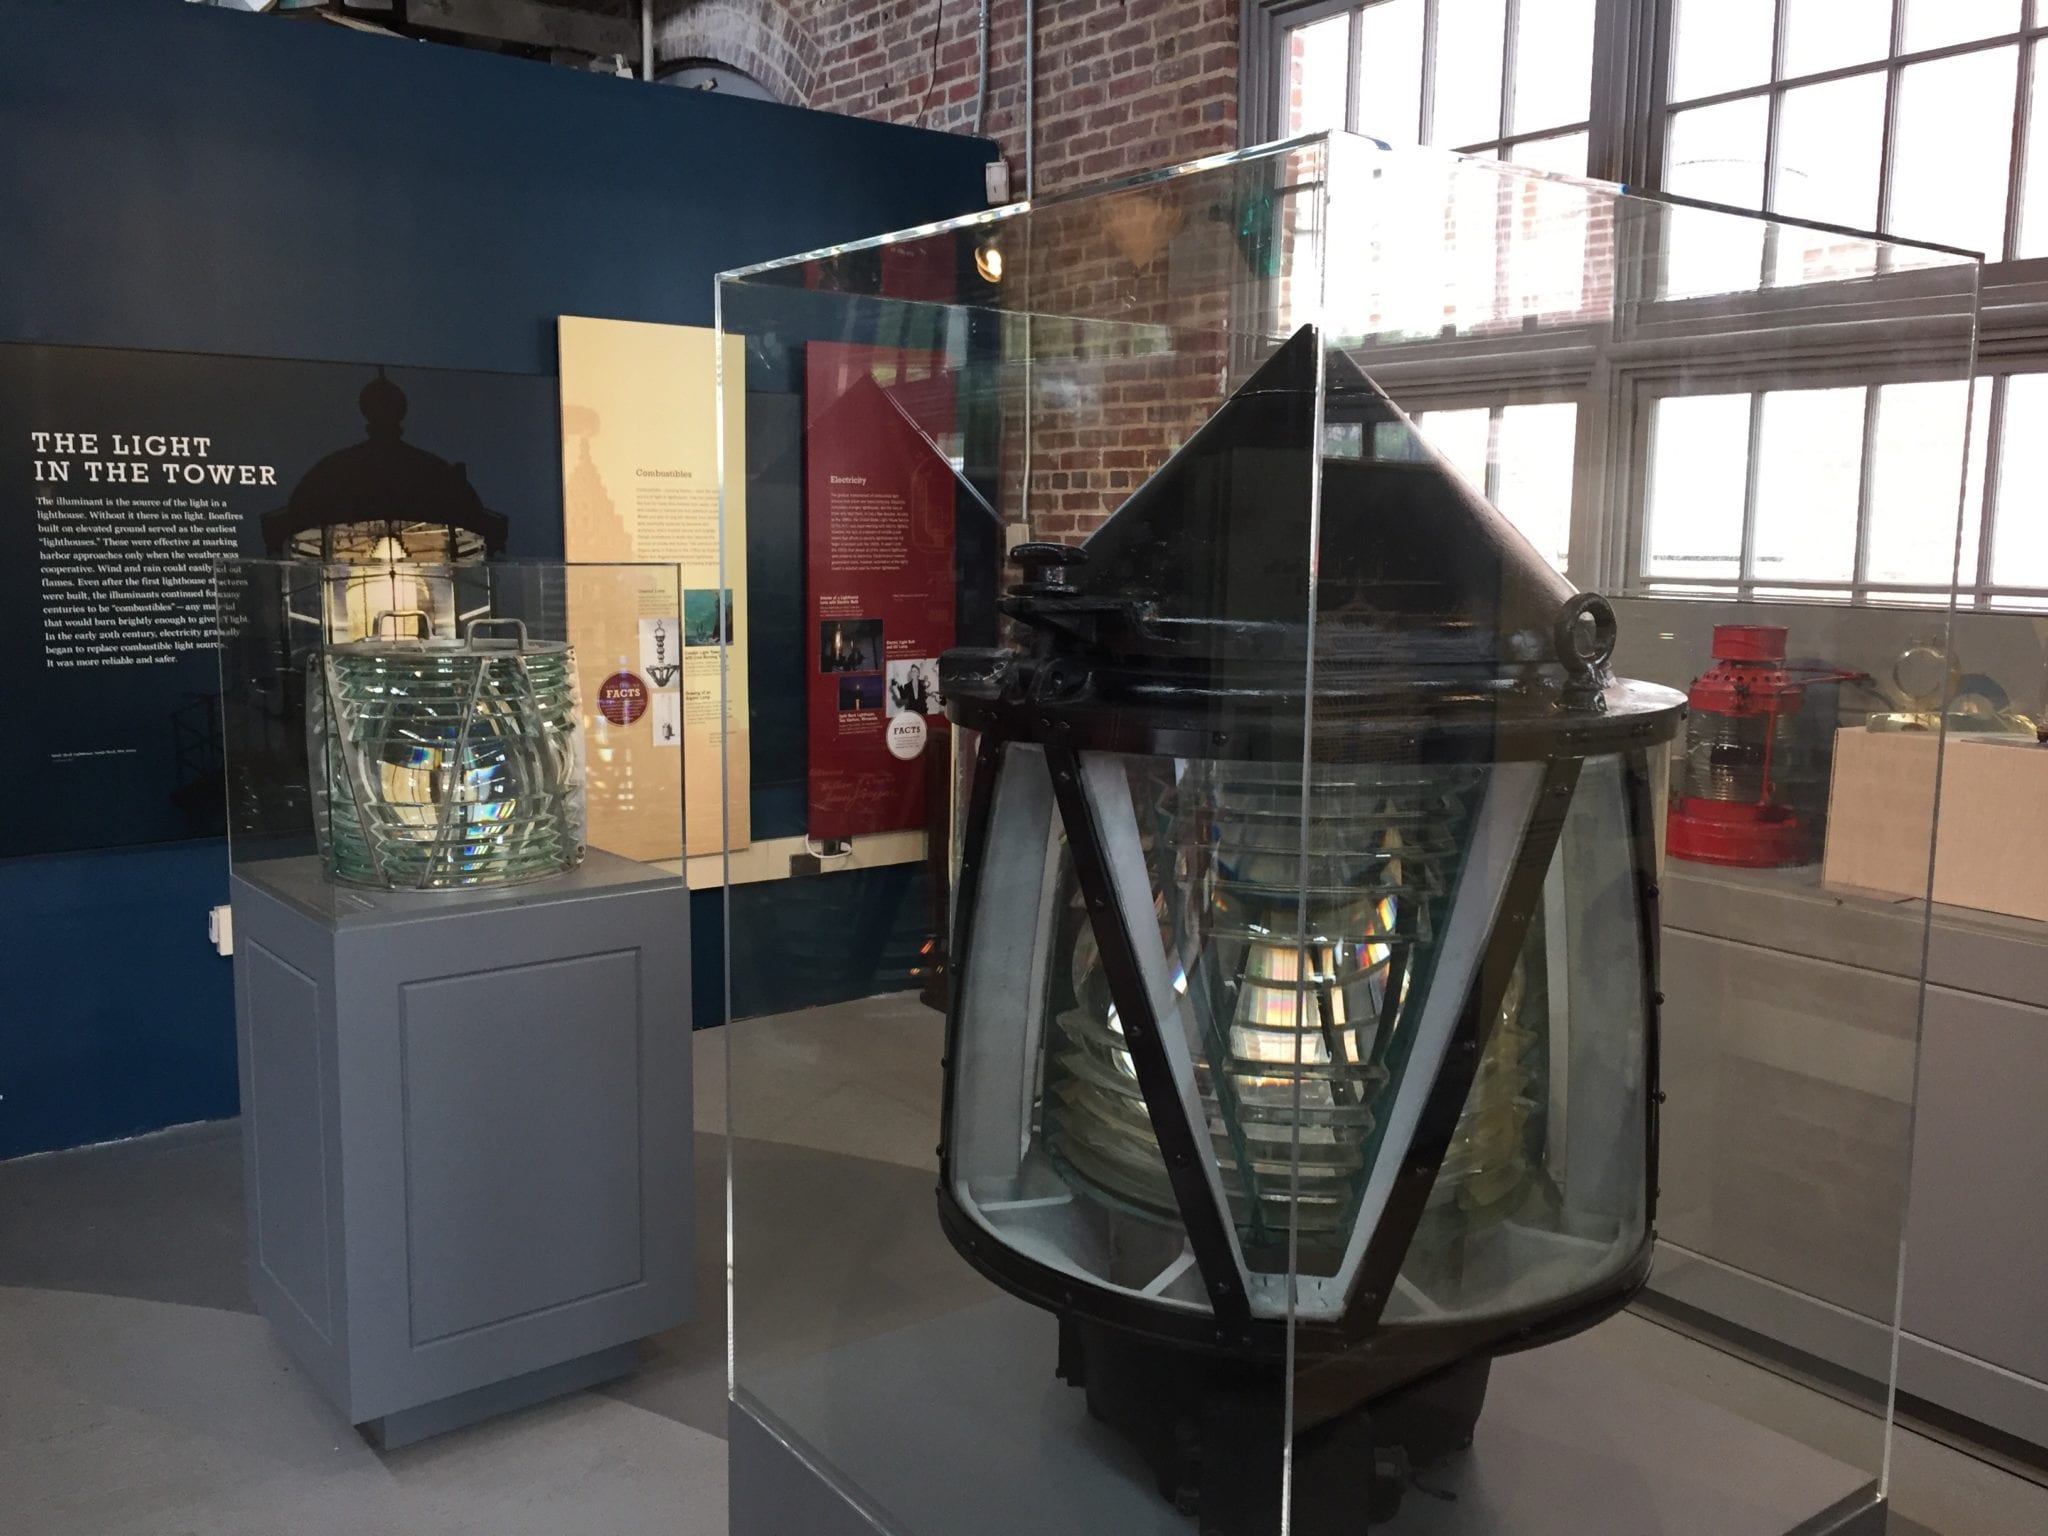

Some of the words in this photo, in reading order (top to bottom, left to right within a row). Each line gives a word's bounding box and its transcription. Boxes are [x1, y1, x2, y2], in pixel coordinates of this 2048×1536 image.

[32, 432, 98, 454] THE
[112, 434, 210, 457] LIGHT
[34, 460, 70, 481] IN
[84, 462, 149, 483] THE
[162, 464, 277, 485] TOWER
[636, 468, 692, 478] Combustibles
[830, 476, 867, 486] Electricity
[36, 496, 53, 506] The
[56, 496, 103, 507] illuminant
[105, 496, 113, 507] is
[115, 496, 130, 507] the
[132, 499, 160, 507] source
[162, 497, 172, 507] of
[173, 497, 187, 507] the
[188, 497, 208, 510] light
[210, 497, 220, 508] in
[221, 500, 227, 508] a
[88, 509, 125, 520] Without
[127, 509, 134, 520] it
[136, 509, 159, 520] there
[161, 510, 169, 520] is
[170, 512, 182, 520] no
[208, 510, 244, 521] Bonfires
[38, 522, 59, 533] built
[61, 525, 73, 533] on
[75, 522, 112, 533] elevated
[114, 523, 146, 536] ground
[147, 523, 176, 534] served
[178, 526, 188, 534] as
[189, 523, 204, 534] the
[205, 523, 236, 534] earliest
[102, 536, 128, 547] These
[130, 539, 152, 547] were
[153, 536, 190, 547] effective
[192, 536, 200, 547] at
[202, 536, 238, 549] marking
[40, 549, 70, 560] harbor
[72, 549, 122, 562] approaches
[124, 549, 144, 562] only
[145, 549, 169, 559] when
[170, 549, 185, 559] the
[186, 548, 221, 559] weather
[222, 551, 239, 559] was
[40, 562, 94, 576] cooperative.
[97, 562, 122, 573] Wind
[123, 562, 140, 573] and
[142, 562, 161, 573] rain
[162, 562, 186, 573] could
[188, 562, 212, 575] easily
[41, 576, 74, 587] flames.
[77, 576, 99, 587] Even
[101, 576, 123, 586] after
[124, 575, 139, 586] the
[141, 575, 159, 586] first
[161, 574, 206, 588] lighthouse
[42, 592, 64, 601] were
[66, 589, 90, 603] built,
[92, 589, 106, 600] the
[109, 588, 159, 600] illuminants
[160, 588, 203, 599] continued
[42, 603, 85, 614] centuries
[86, 602, 96, 613] to
[98, 602, 109, 613] be
[44, 616, 62, 628] that
[64, 616, 92, 627] would
[94, 615, 116, 626] burn
[118, 614, 152, 628] brightly
[154, 614, 186, 627] enough
[187, 613, 196, 624] to
[198, 613, 216, 626] give
[45, 630, 55, 641] In
[57, 630, 72, 640] the
[74, 629, 96, 642] early
[159, 626, 201, 640] electricity
[45, 643, 72, 657] began
[74, 642, 84, 653] to
[86, 641, 118, 655] replace
[120, 639, 172, 652] combustible
[174, 638, 193, 652] light
[47, 657, 53, 668] It
[56, 659, 74, 668] was
[76, 658, 99, 667] more
[101, 654, 134, 666] reliable
[135, 654, 152, 665] and
[606, 688, 641, 698] FACTS
[894, 726, 920, 735] FACTS
